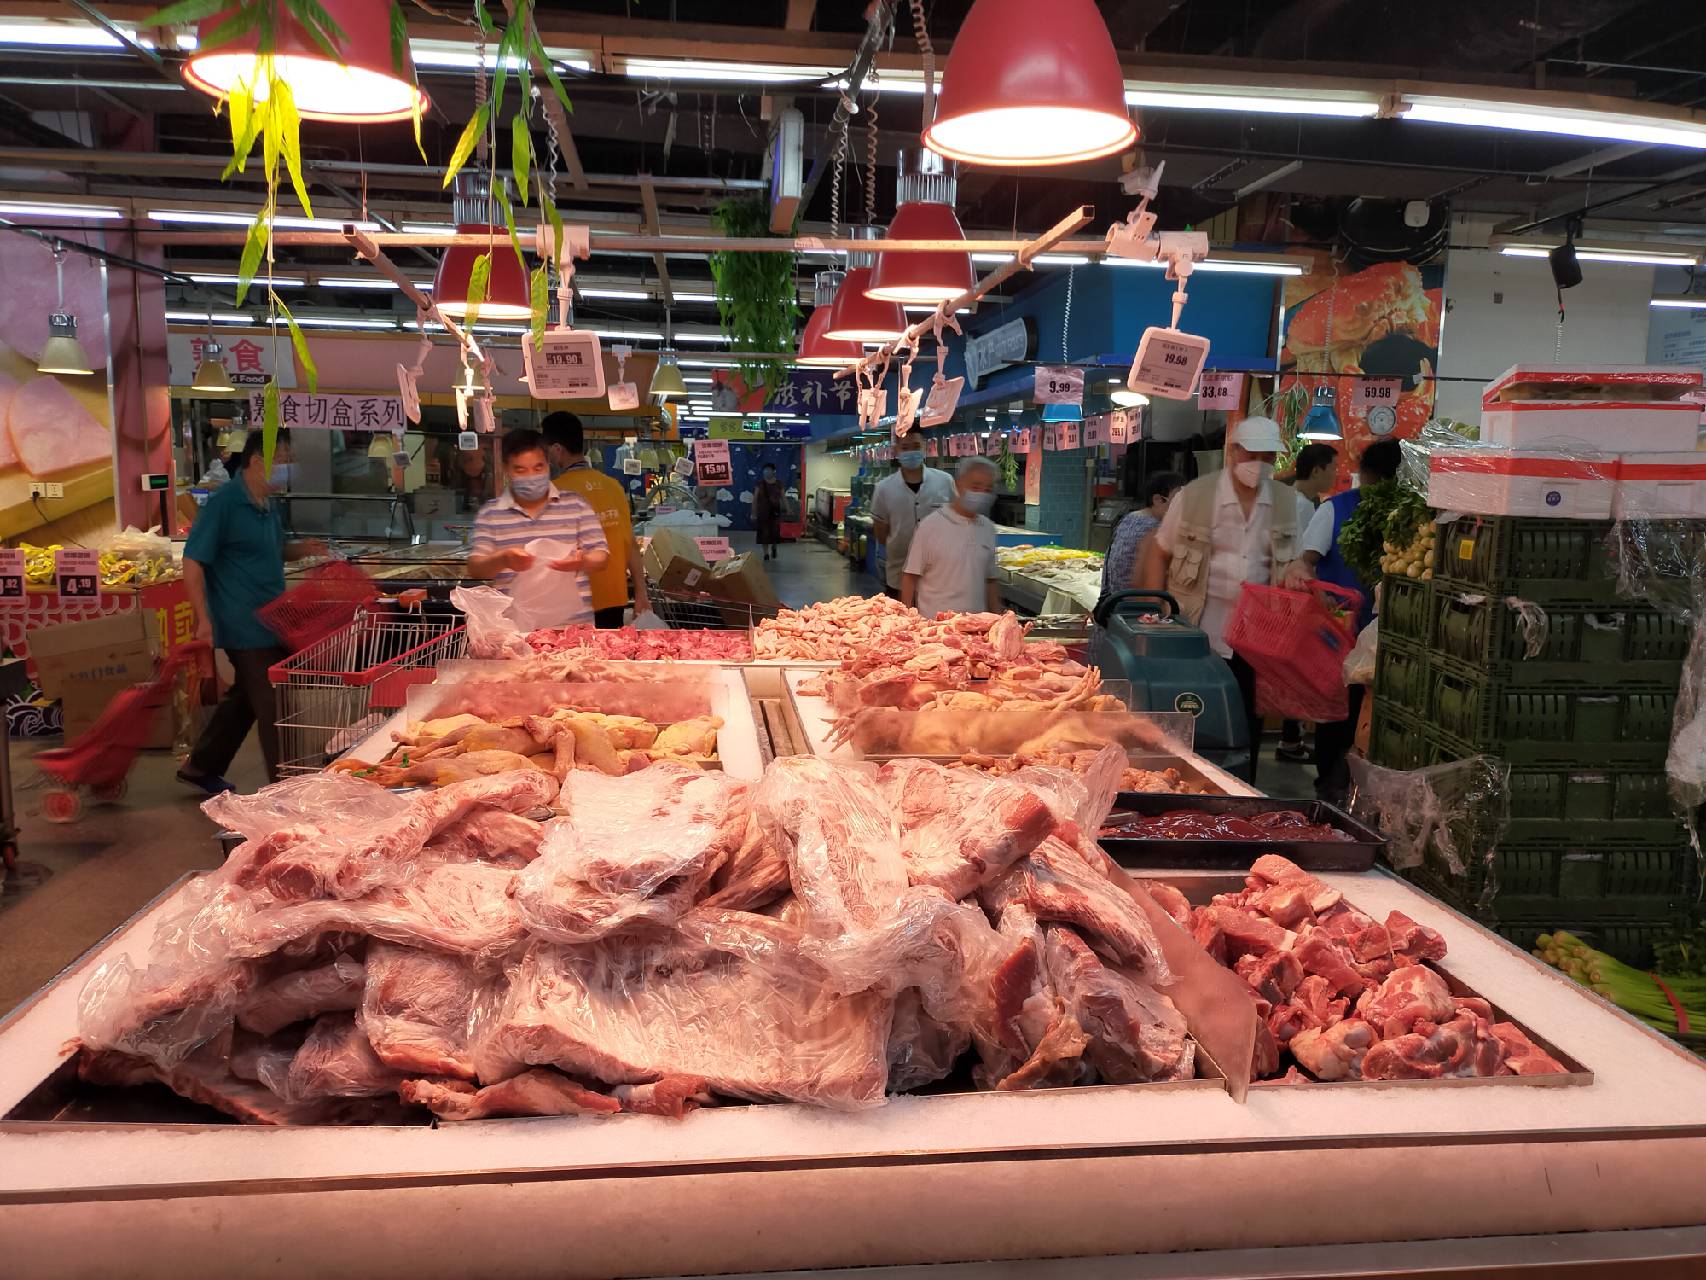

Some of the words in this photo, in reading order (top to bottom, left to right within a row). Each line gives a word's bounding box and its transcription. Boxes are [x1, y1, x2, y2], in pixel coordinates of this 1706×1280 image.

[552, 354, 578, 365] 19.90
[239, 375, 265, 383] Food
[1049, 380, 1071, 393] 9.99
